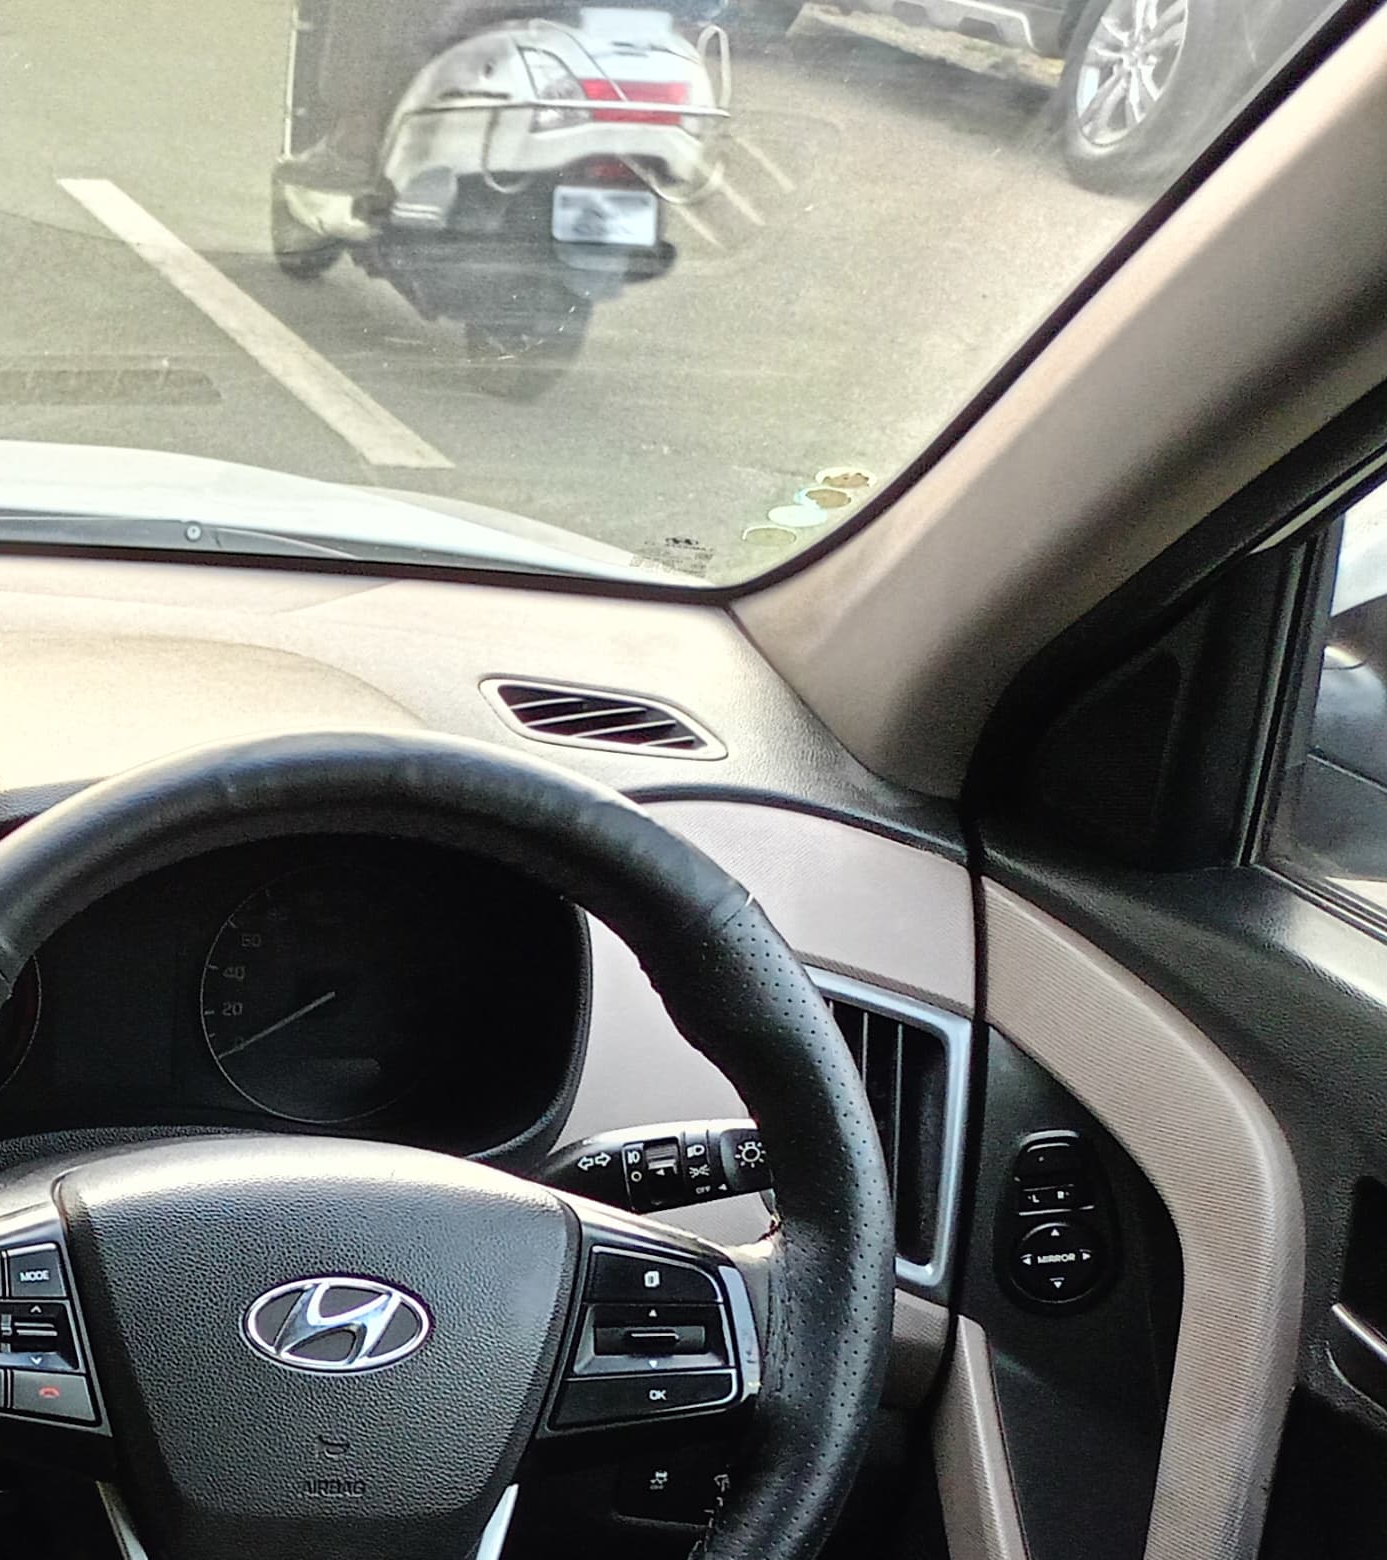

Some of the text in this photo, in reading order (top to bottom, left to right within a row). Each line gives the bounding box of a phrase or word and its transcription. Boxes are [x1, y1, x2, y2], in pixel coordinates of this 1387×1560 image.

[221, 1002, 241, 1016] 20
[1036, 1252, 1077, 1264] MIRROR
[19, 1270, 50, 1282] MODE
[649, 1388, 667, 1400] OK
